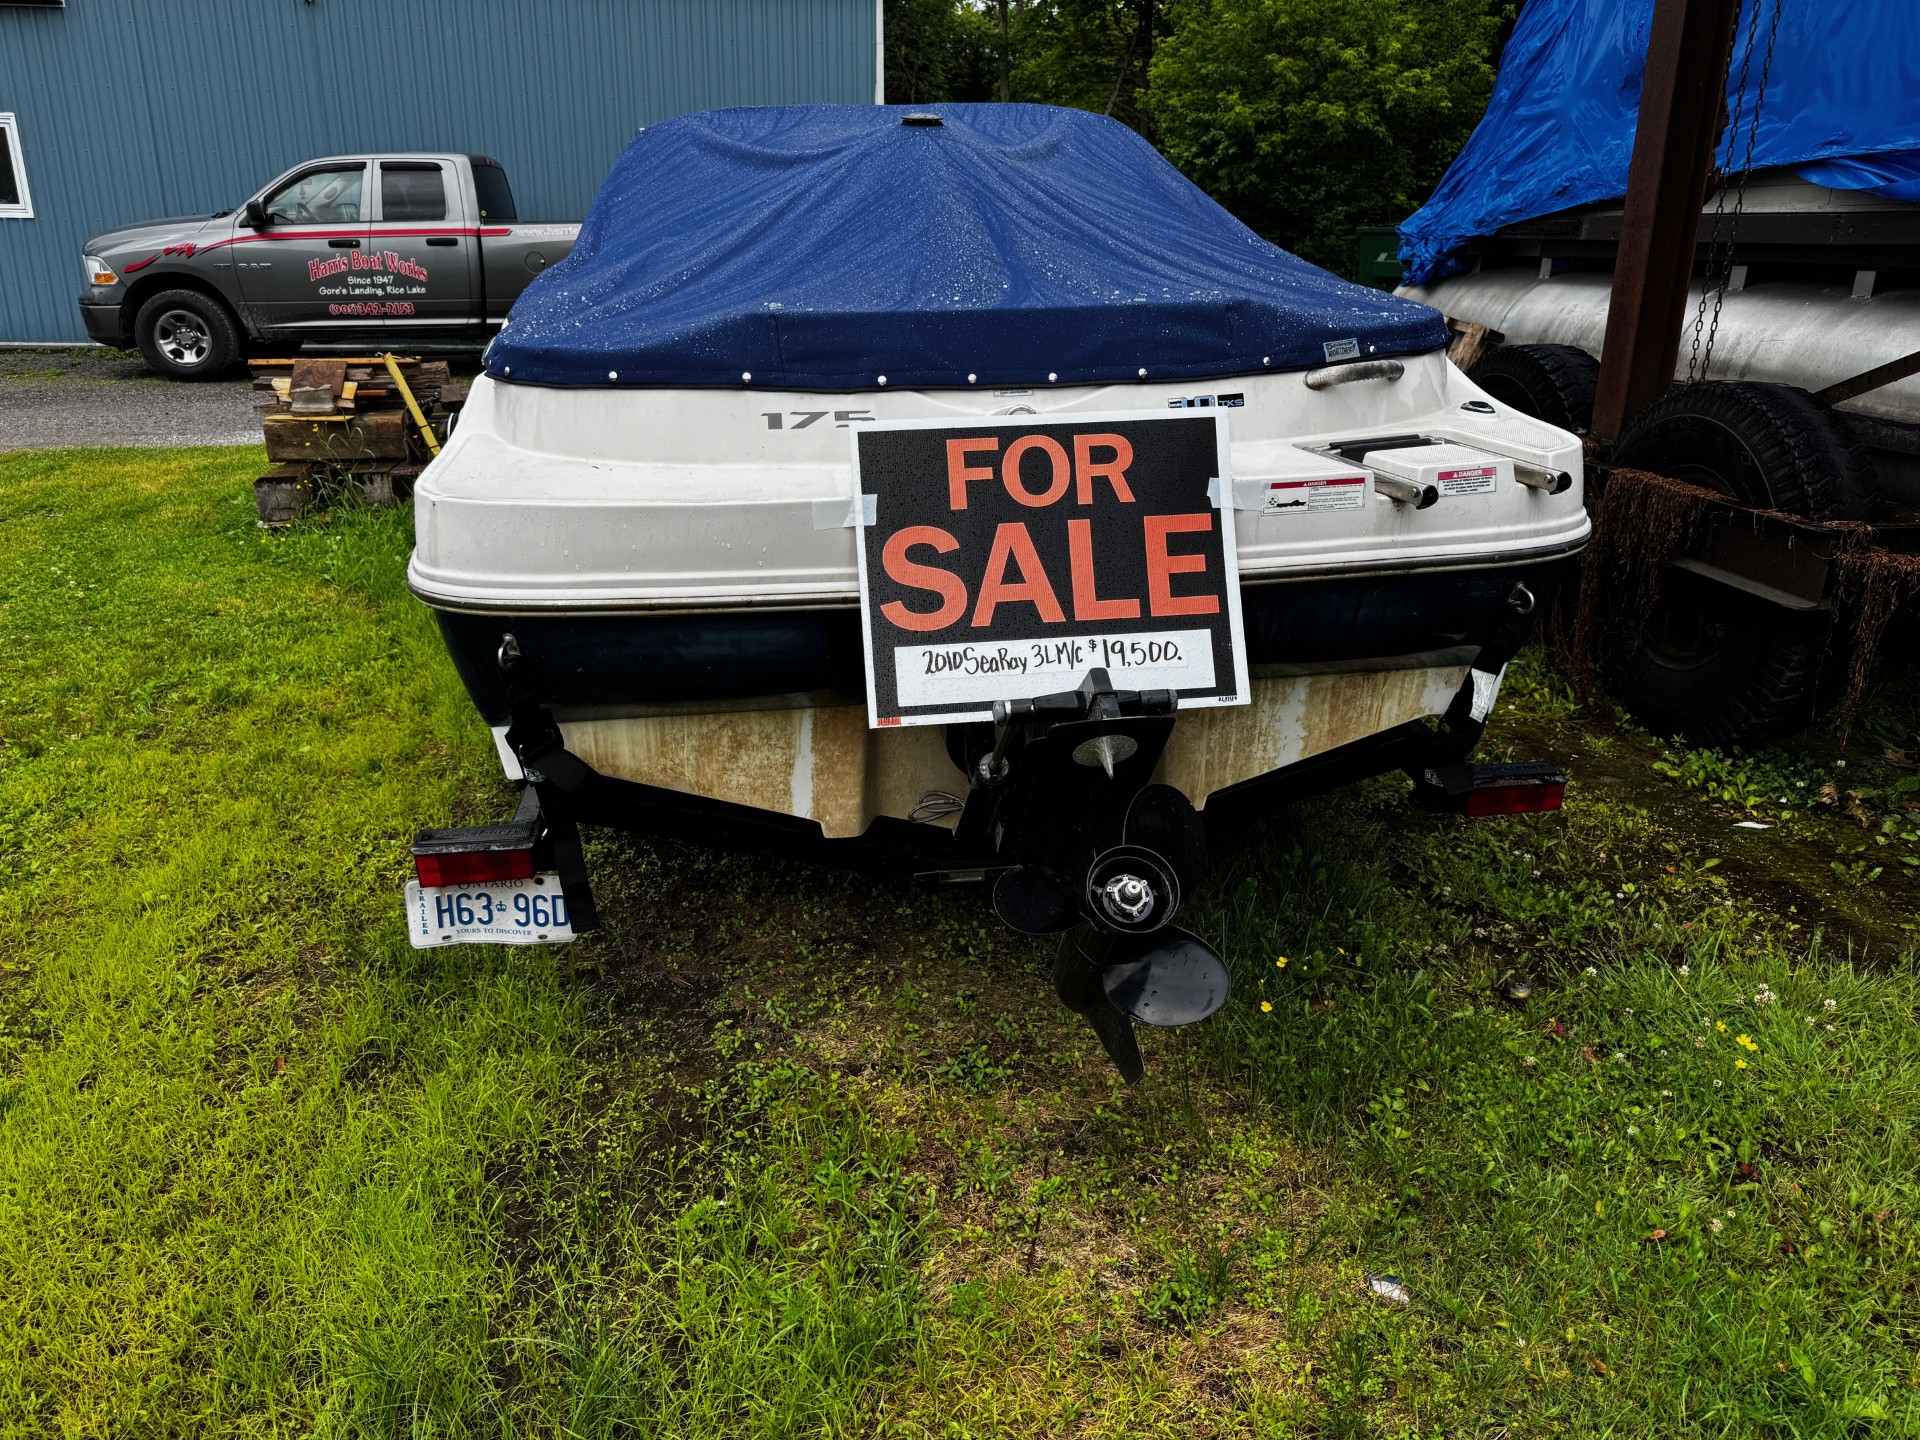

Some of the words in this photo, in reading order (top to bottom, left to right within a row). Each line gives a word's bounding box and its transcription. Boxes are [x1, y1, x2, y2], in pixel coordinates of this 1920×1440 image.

[308, 253, 348, 281] Harris
[350, 249, 383, 270] Boat
[384, 250, 428, 282] Works
[319, 286, 347, 295] Gore's
[349, 287, 385, 296] Landing,
[386, 286, 404, 294] Rice
[406, 285, 426, 294] Lake
[347, 276, 371, 285] Since
[373, 275, 393, 284] 1947
[760, 410, 876, 430] 175
[946, 432, 1136, 511] FOR
[1458, 469, 1483, 478] DANGER
[879, 512, 1220, 632] SALE
[417, 889, 430, 936] TRAILER
[435, 893, 494, 929] H63
[513, 893, 570, 928] 96D
[456, 927, 481, 935] YOURS
[496, 928, 532, 936] DISCOVER
